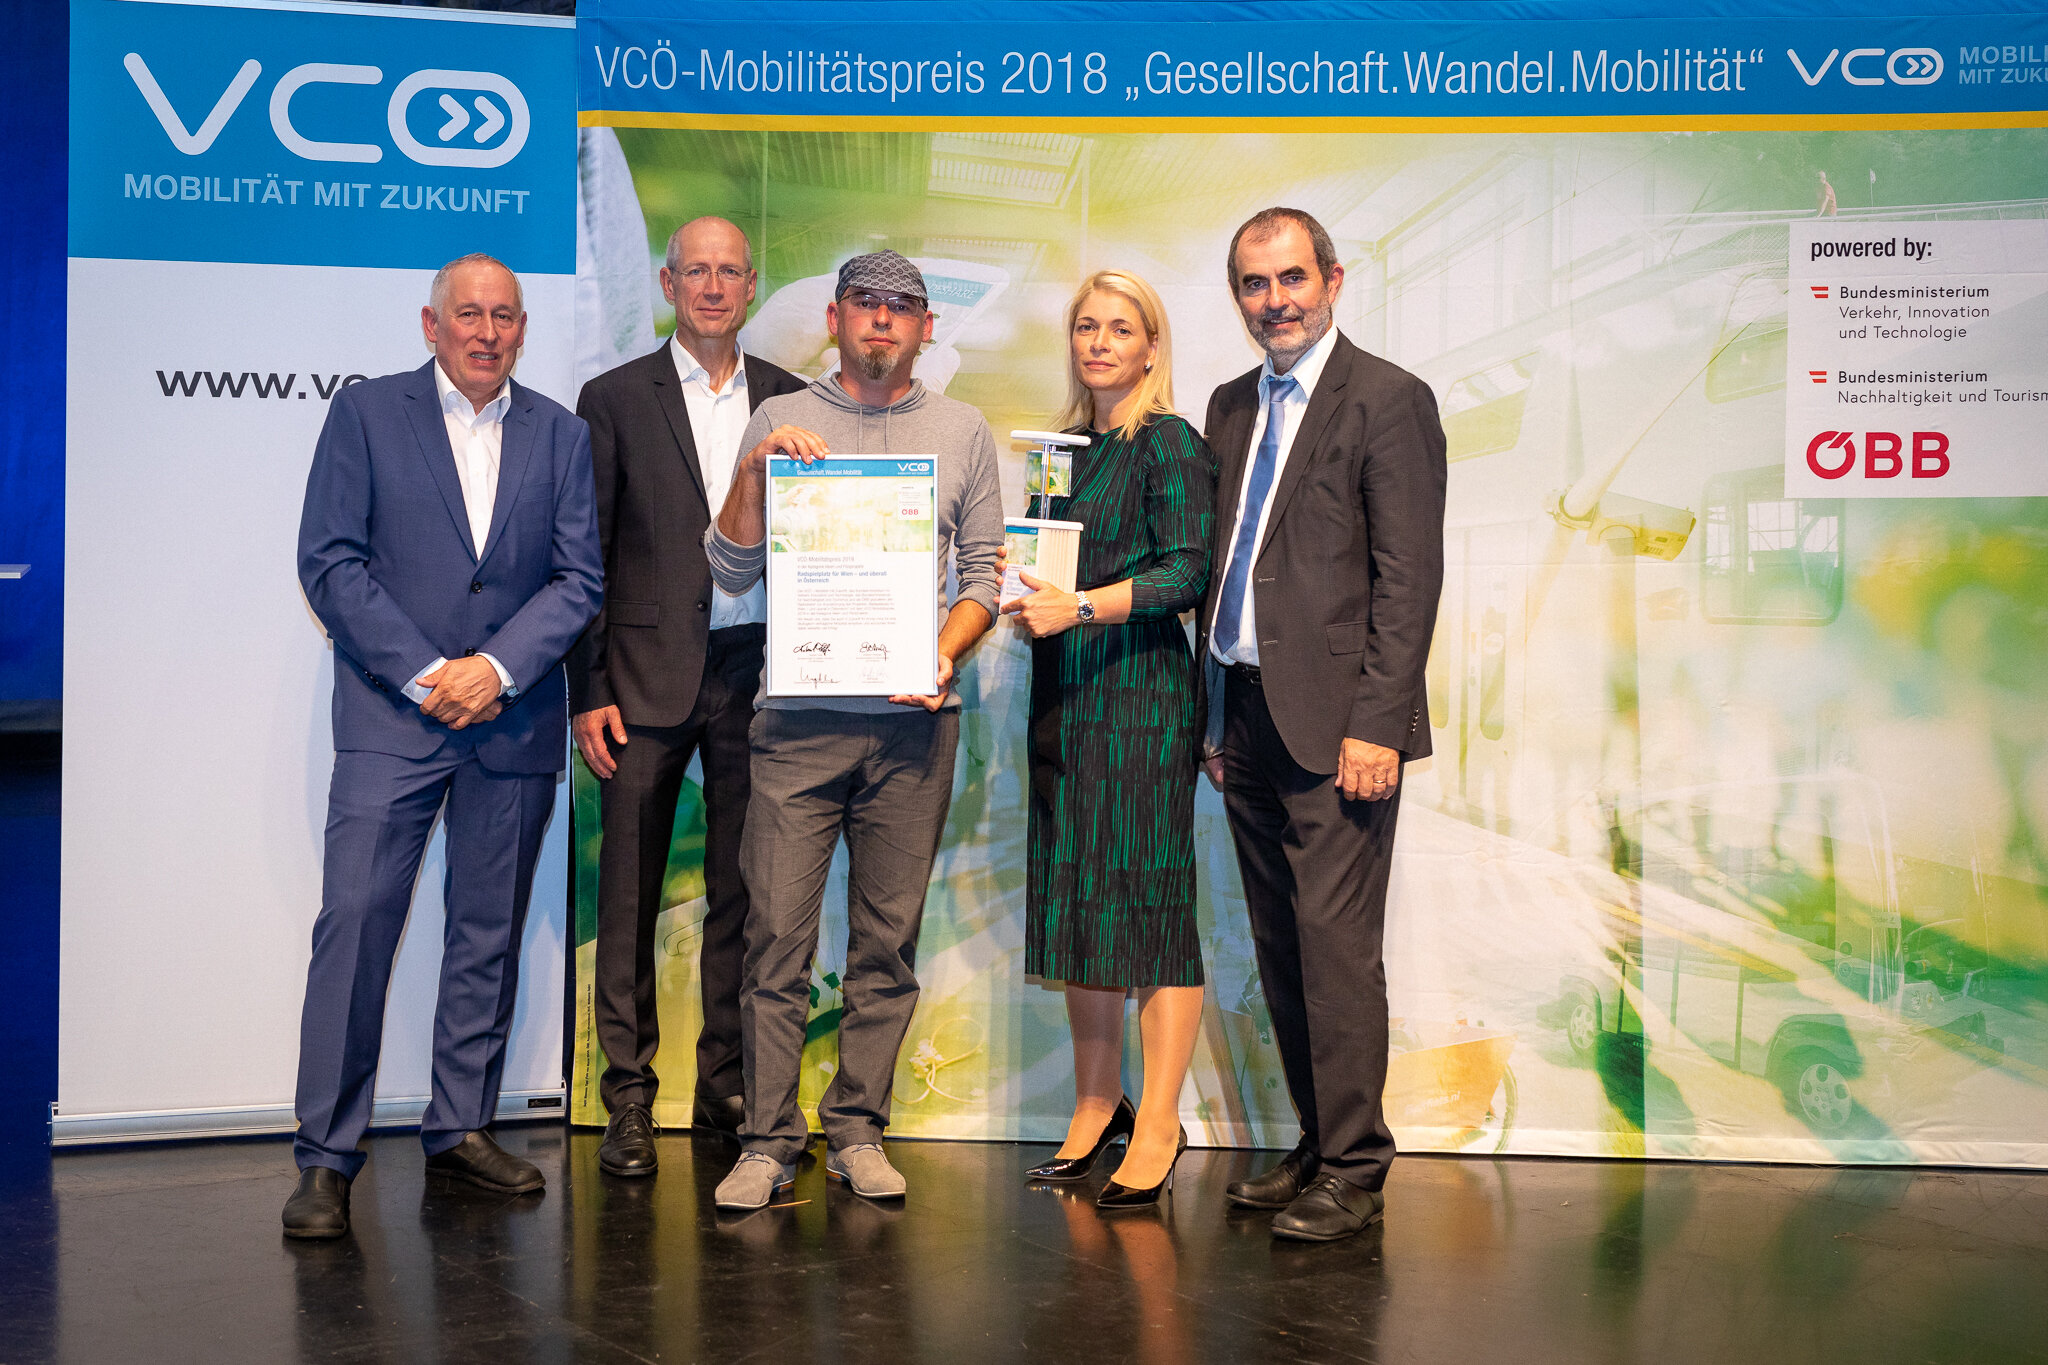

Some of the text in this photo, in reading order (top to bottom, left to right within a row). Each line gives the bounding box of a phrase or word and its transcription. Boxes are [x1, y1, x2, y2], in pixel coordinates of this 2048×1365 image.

[594, 39, 985, 103] VCÖ-Mobilitätspreis
[1001, 50, 1107, 95] 2018
[1959, 68, 1996, 85] MIT
[124, 173, 530, 214] MOBILITÄT MIT ZUKUNFT
[1811, 237, 1932, 262] powered by:
[1840, 284, 1990, 299] Bundesministerium
[1839, 304, 1990, 321] Verkehr, Innovation
[1839, 324, 1967, 342] und Technologie
[1838, 369, 1988, 384] Bundesministerium
[1838, 389, 1953, 407] Nachhaltigkeit
[1959, 388, 1987, 403] und
